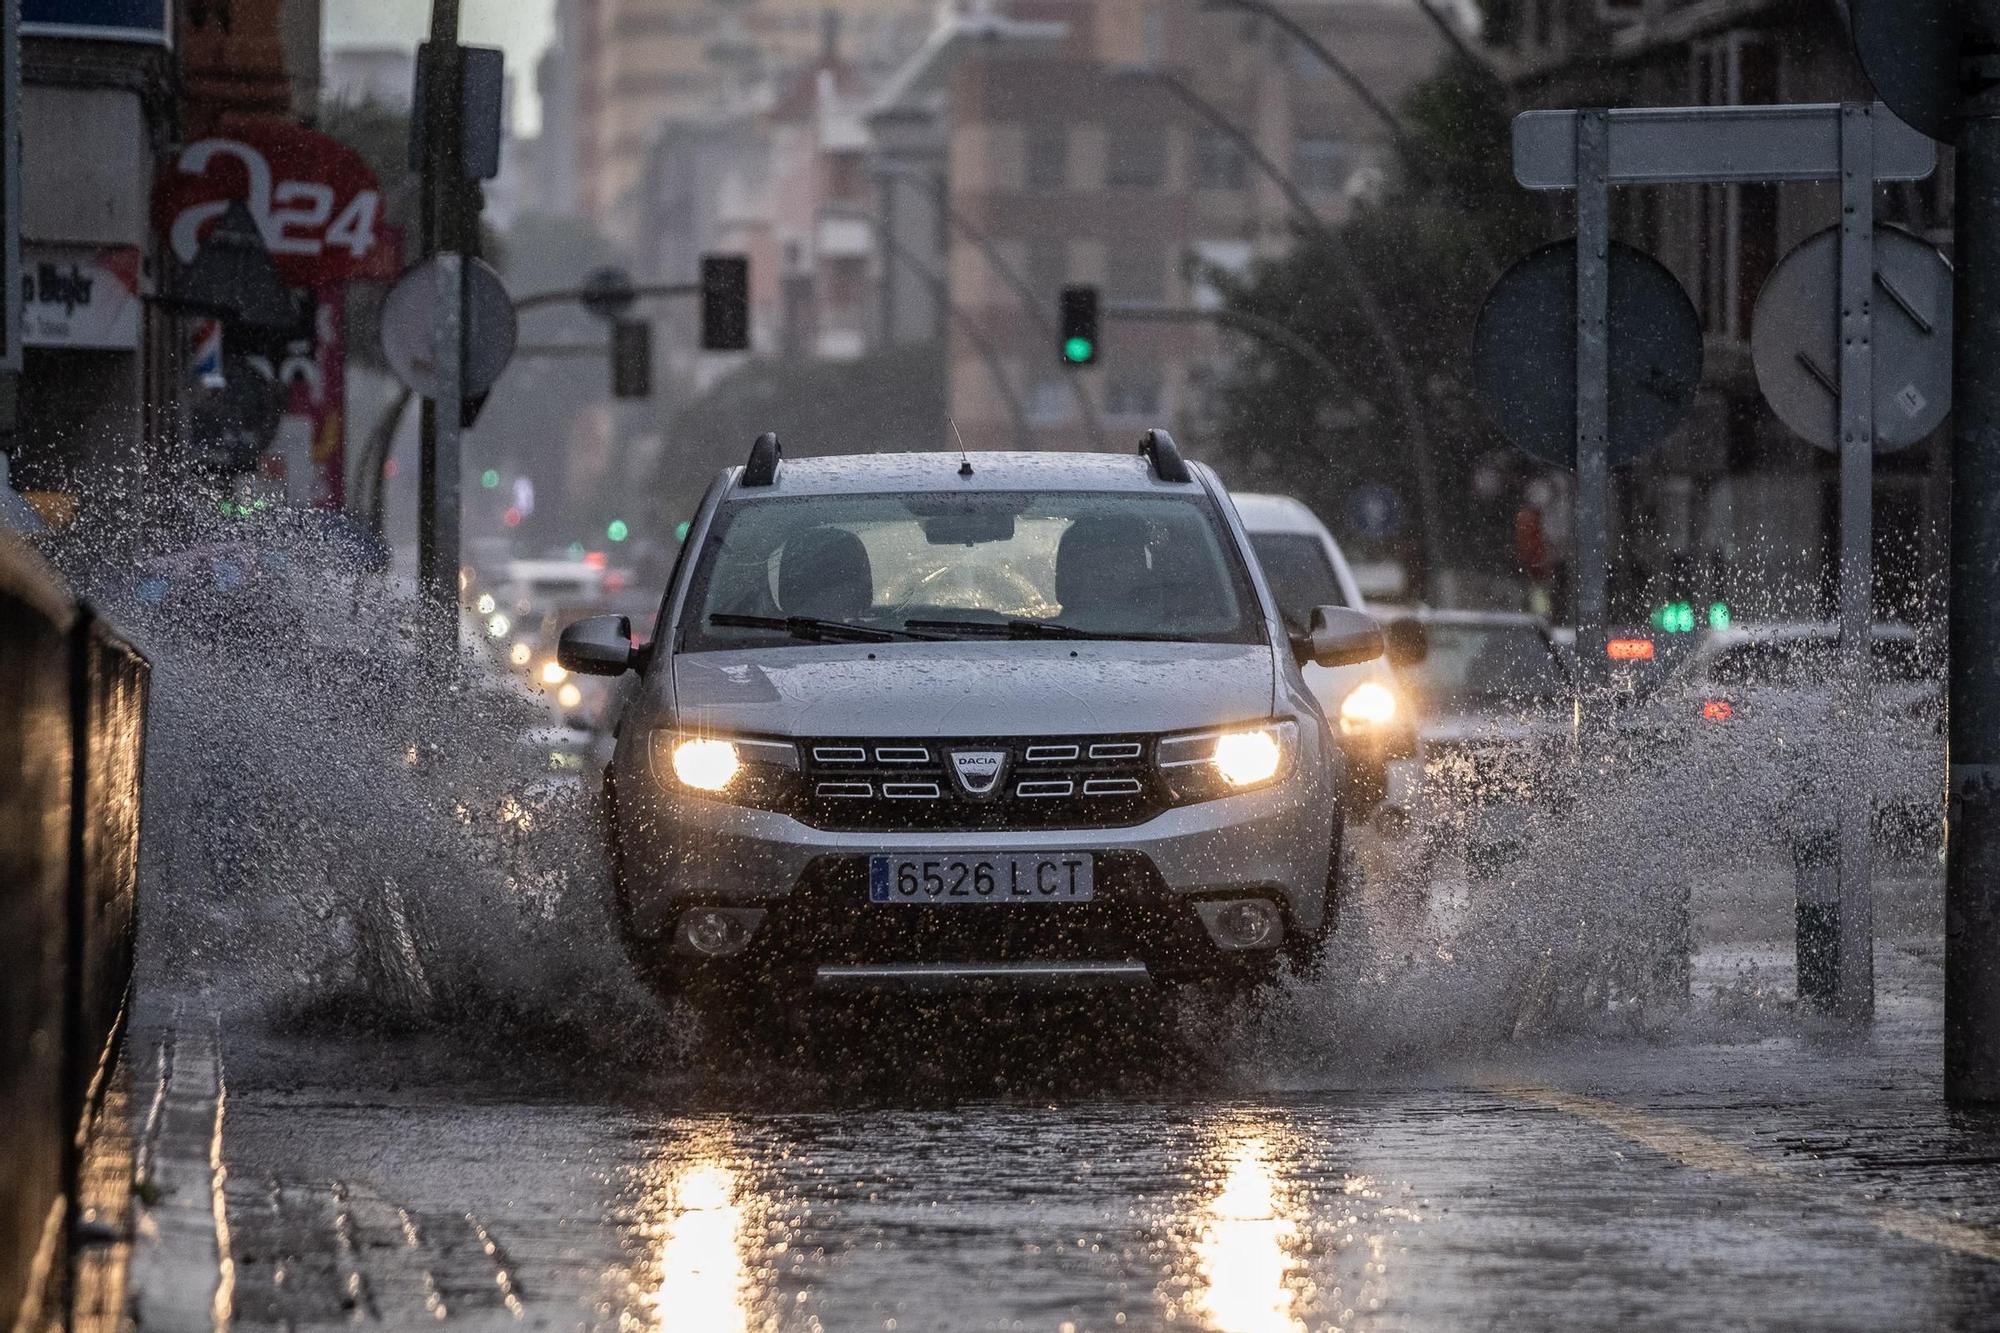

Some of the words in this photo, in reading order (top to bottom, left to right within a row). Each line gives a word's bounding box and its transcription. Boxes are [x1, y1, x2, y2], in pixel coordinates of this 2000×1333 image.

[958, 757, 997, 765] DACIA
[897, 861, 995, 896] 6526
[1010, 860, 1083, 896] LCT
